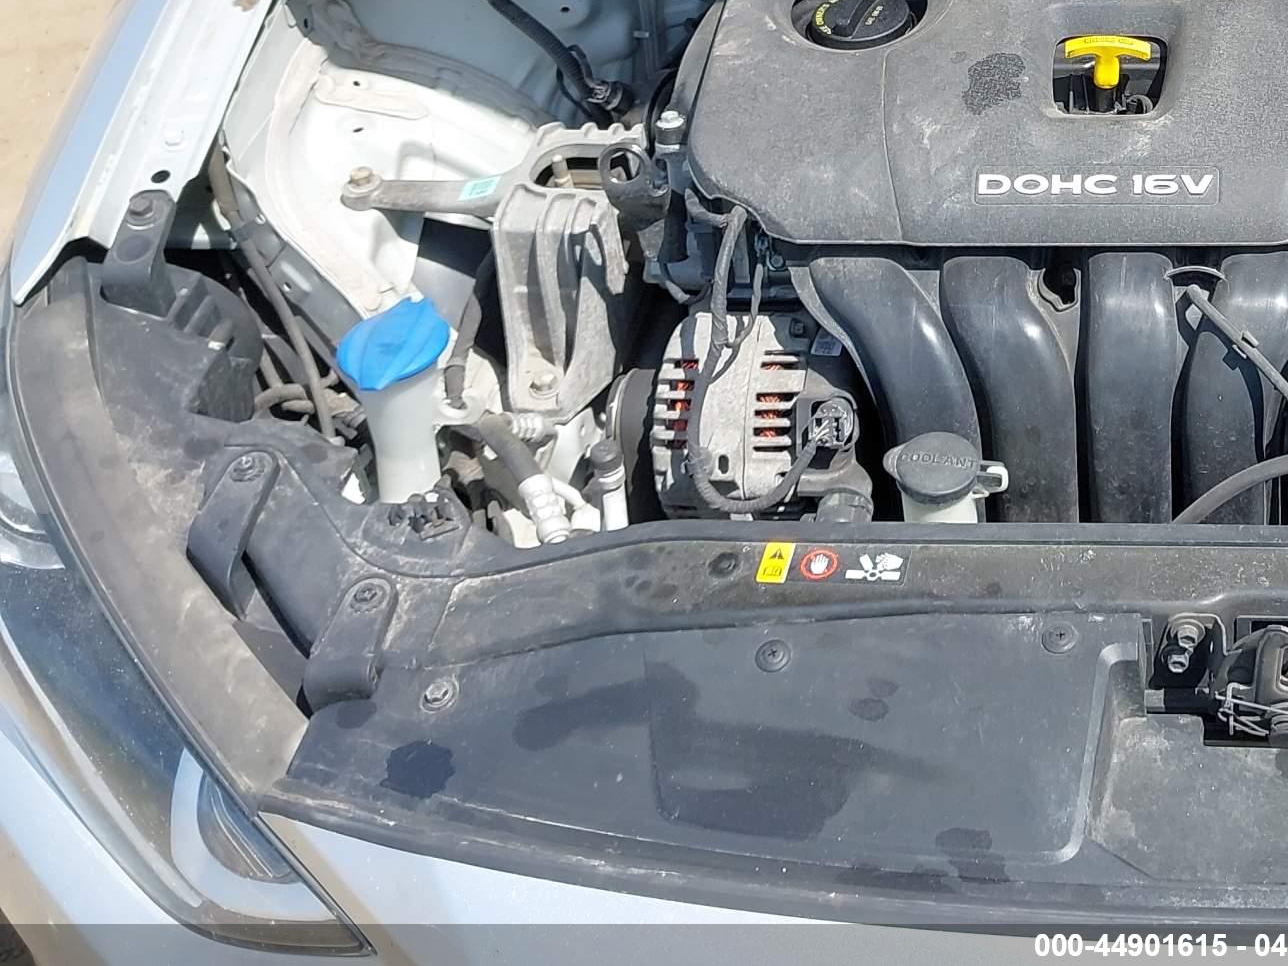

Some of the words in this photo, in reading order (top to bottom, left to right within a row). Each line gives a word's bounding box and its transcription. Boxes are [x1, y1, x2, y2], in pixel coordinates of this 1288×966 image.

[977, 173, 1119, 196] DOHC
[1131, 174, 1214, 196] 16V
[900, 452, 977, 471] COOLANT
